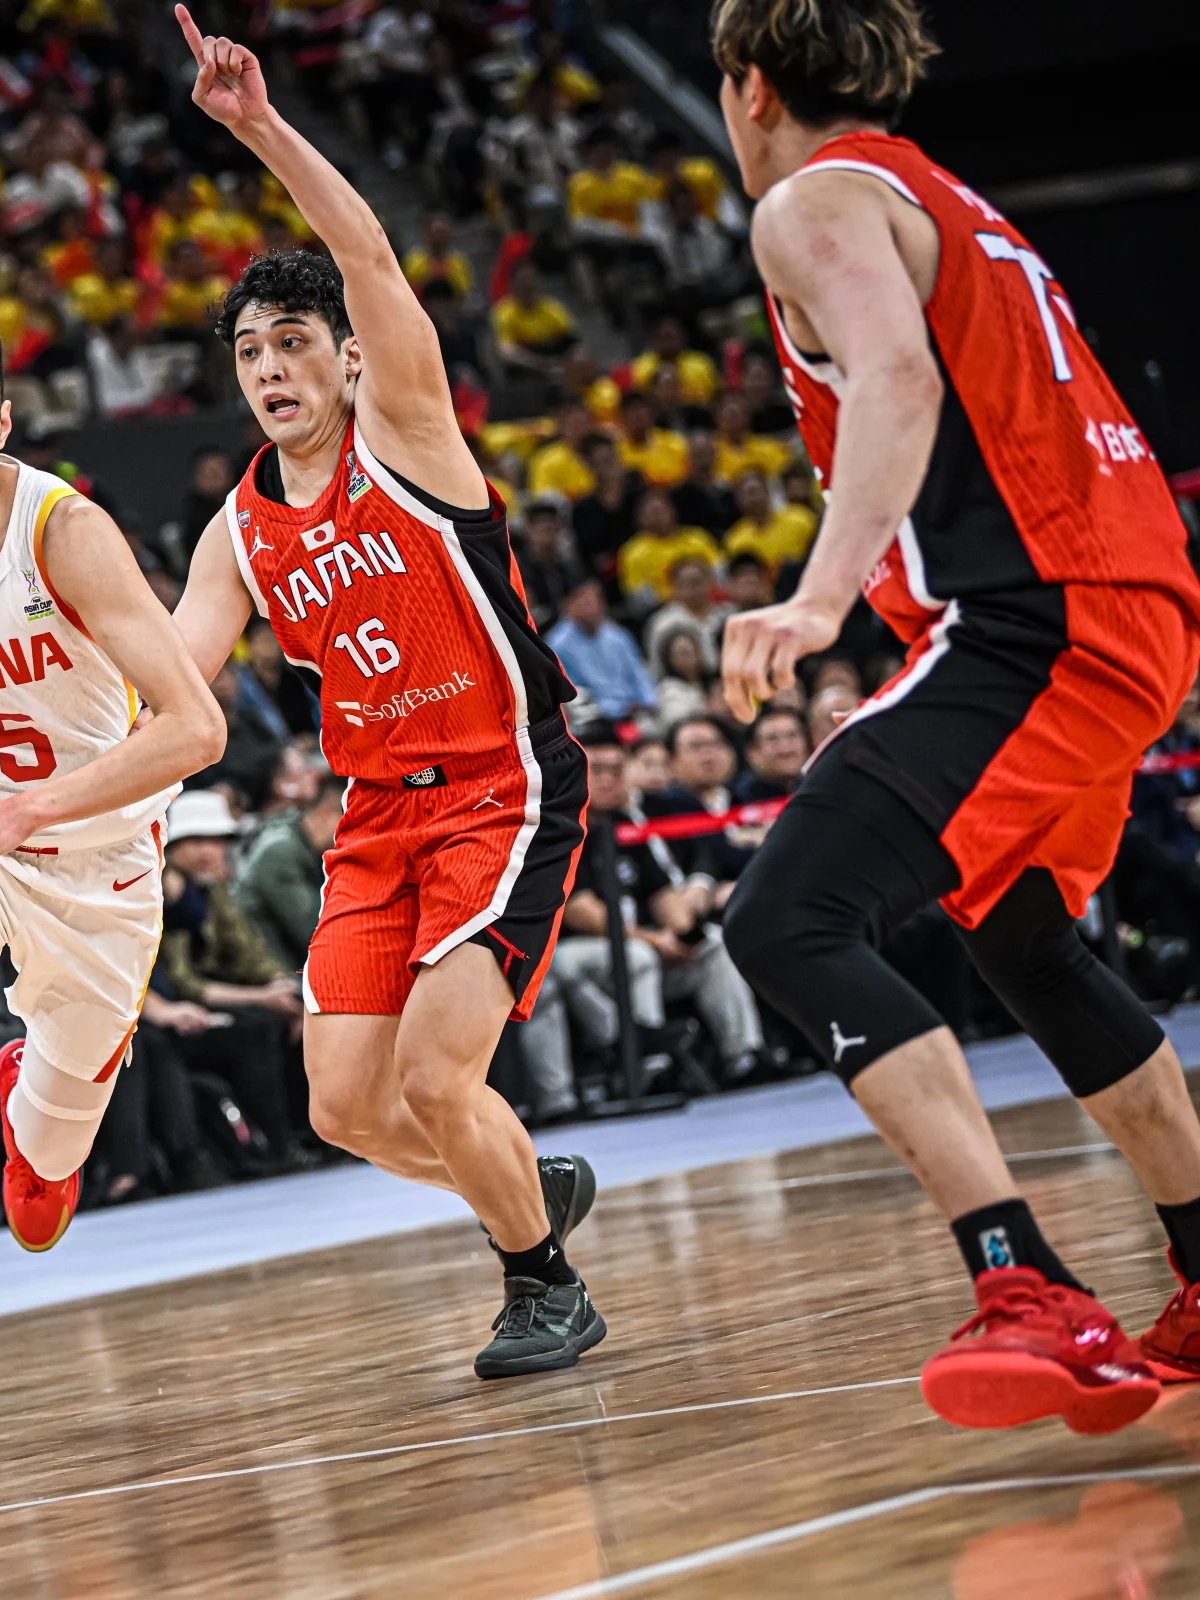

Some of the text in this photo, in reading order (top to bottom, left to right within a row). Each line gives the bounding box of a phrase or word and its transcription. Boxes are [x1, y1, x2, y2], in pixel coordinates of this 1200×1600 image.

[973, 231, 1078, 383] 7
[1100, 423, 1156, 464] 日本
[272, 531, 408, 623] JAPAN
[23, 603, 40, 614] ASIA
[39, 599, 53, 610] CUP
[333, 616, 401, 678] 16
[362, 670, 477, 722] SoftBank
